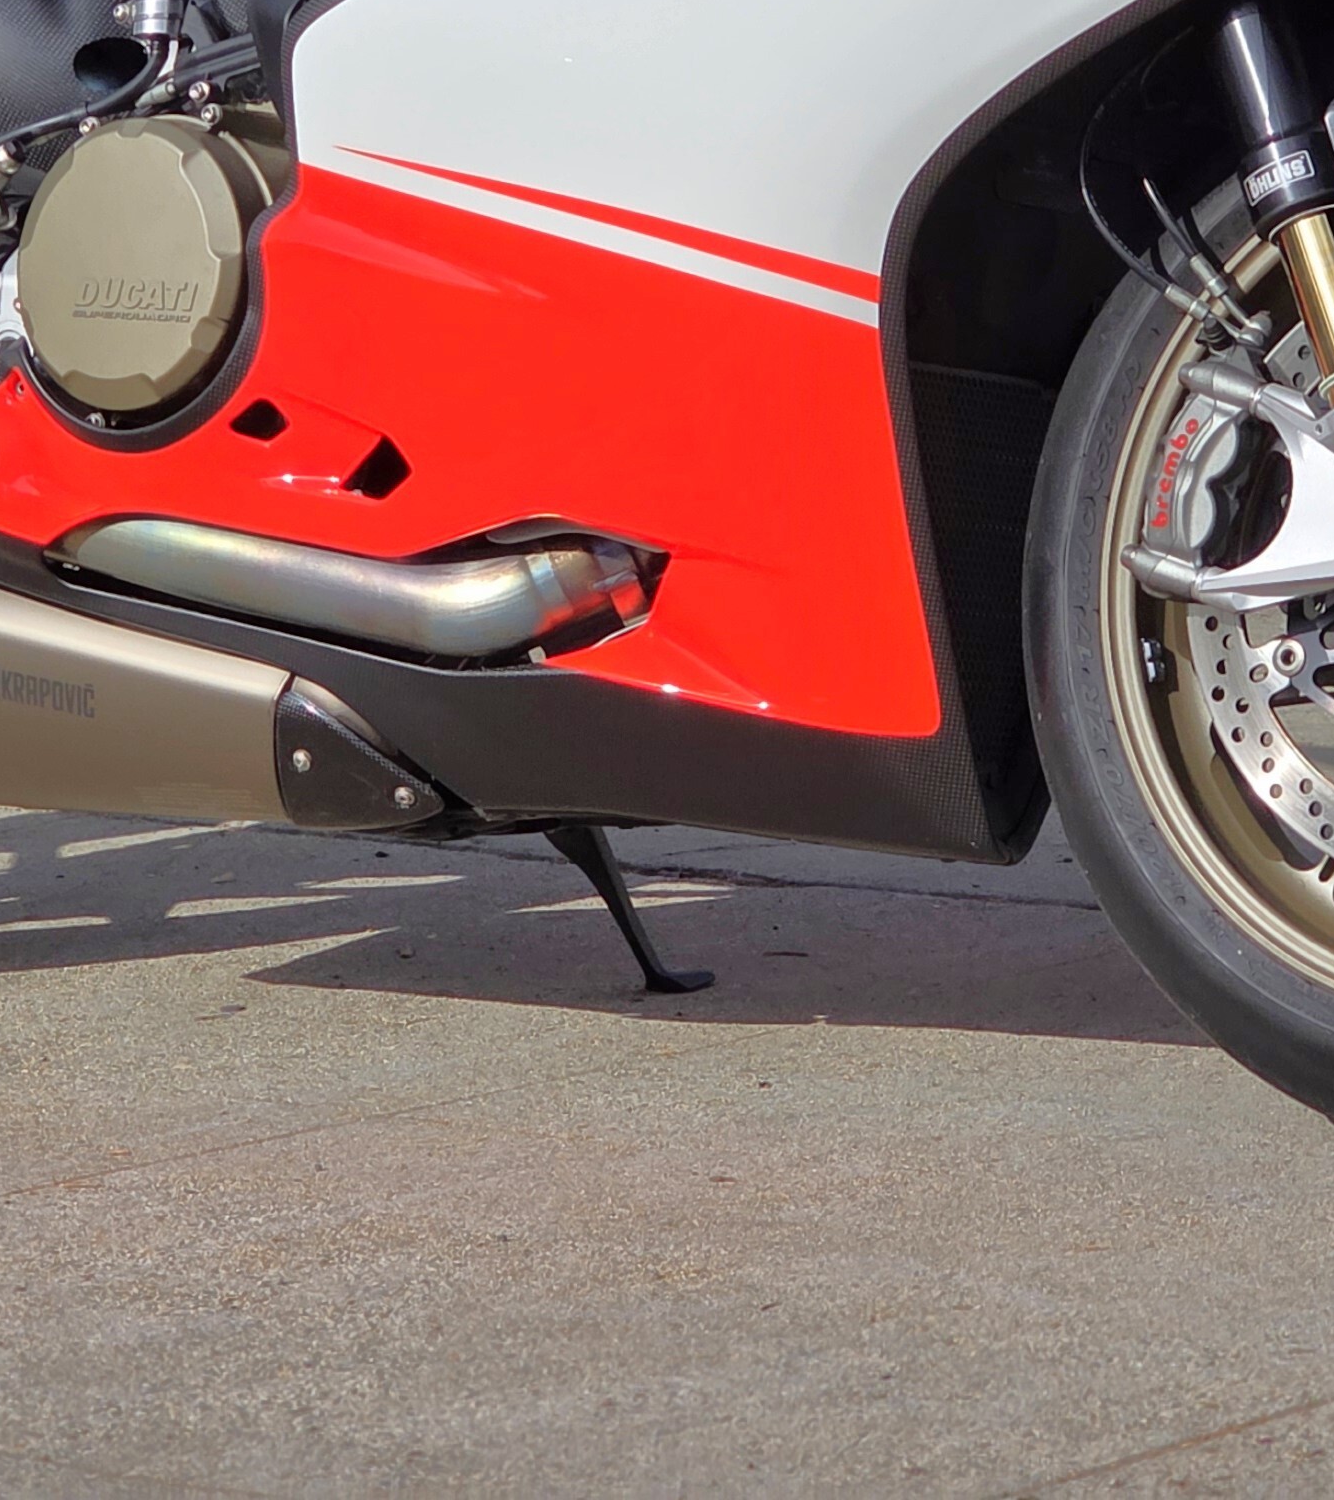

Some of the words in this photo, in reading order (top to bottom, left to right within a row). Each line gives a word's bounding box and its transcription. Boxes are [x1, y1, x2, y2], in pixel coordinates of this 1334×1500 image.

[1248, 158, 1306, 199] ÖHLINS
[74, 277, 199, 312] DUCATI
[1151, 418, 1199, 528] brembo
